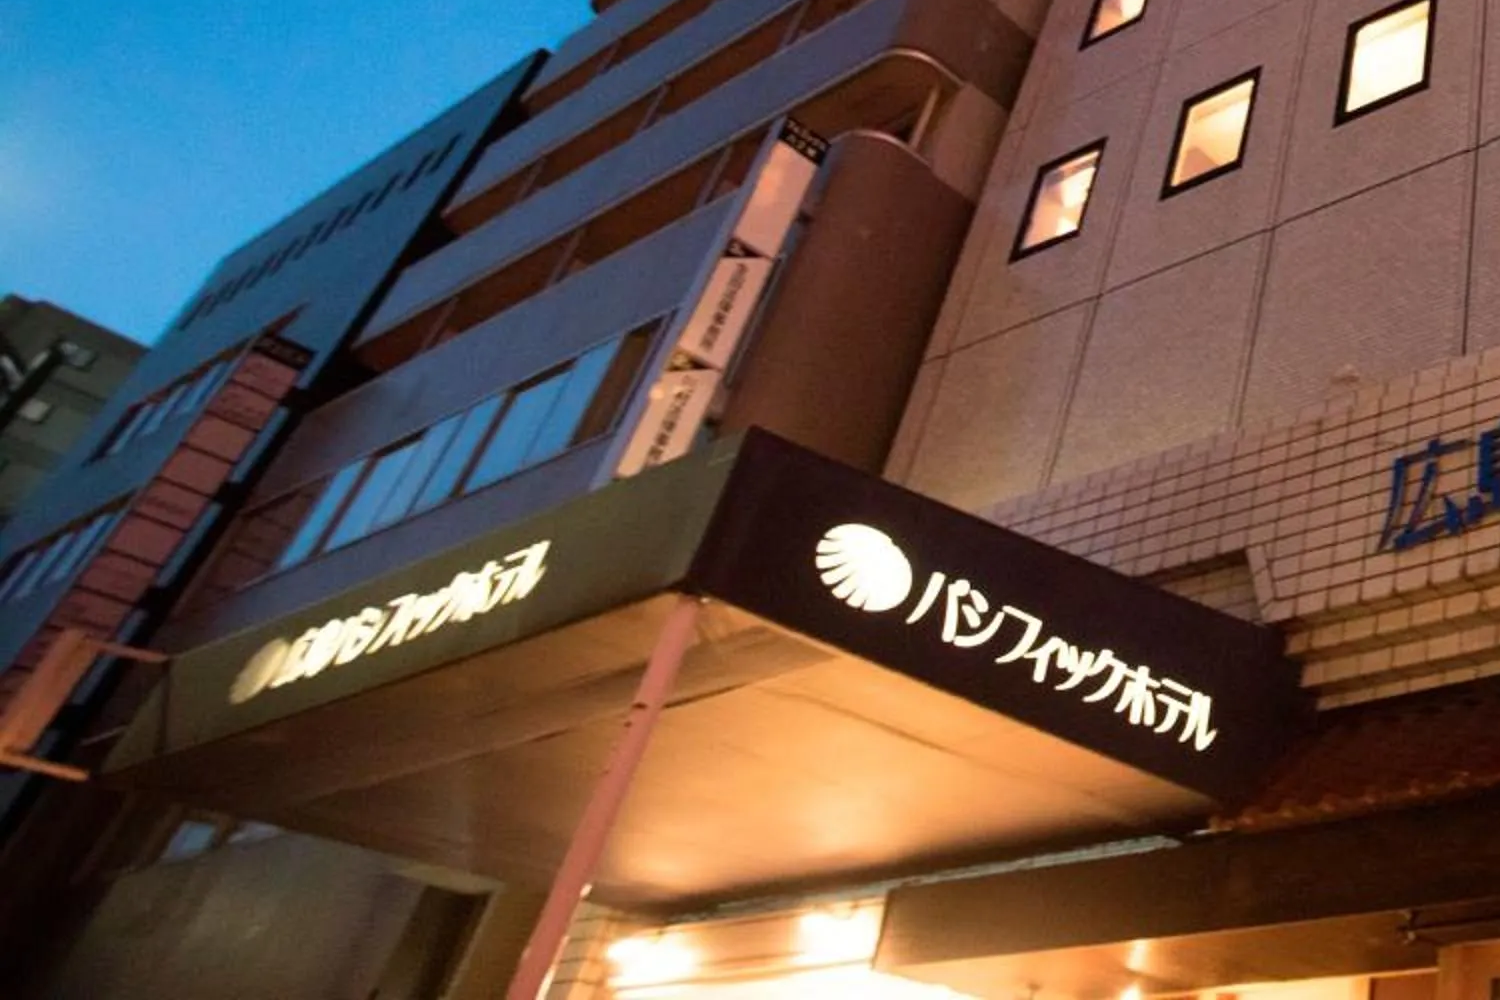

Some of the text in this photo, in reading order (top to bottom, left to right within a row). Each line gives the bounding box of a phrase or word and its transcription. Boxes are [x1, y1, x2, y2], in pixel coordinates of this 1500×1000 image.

[905, 571, 1218, 752] パシフィックホテル
